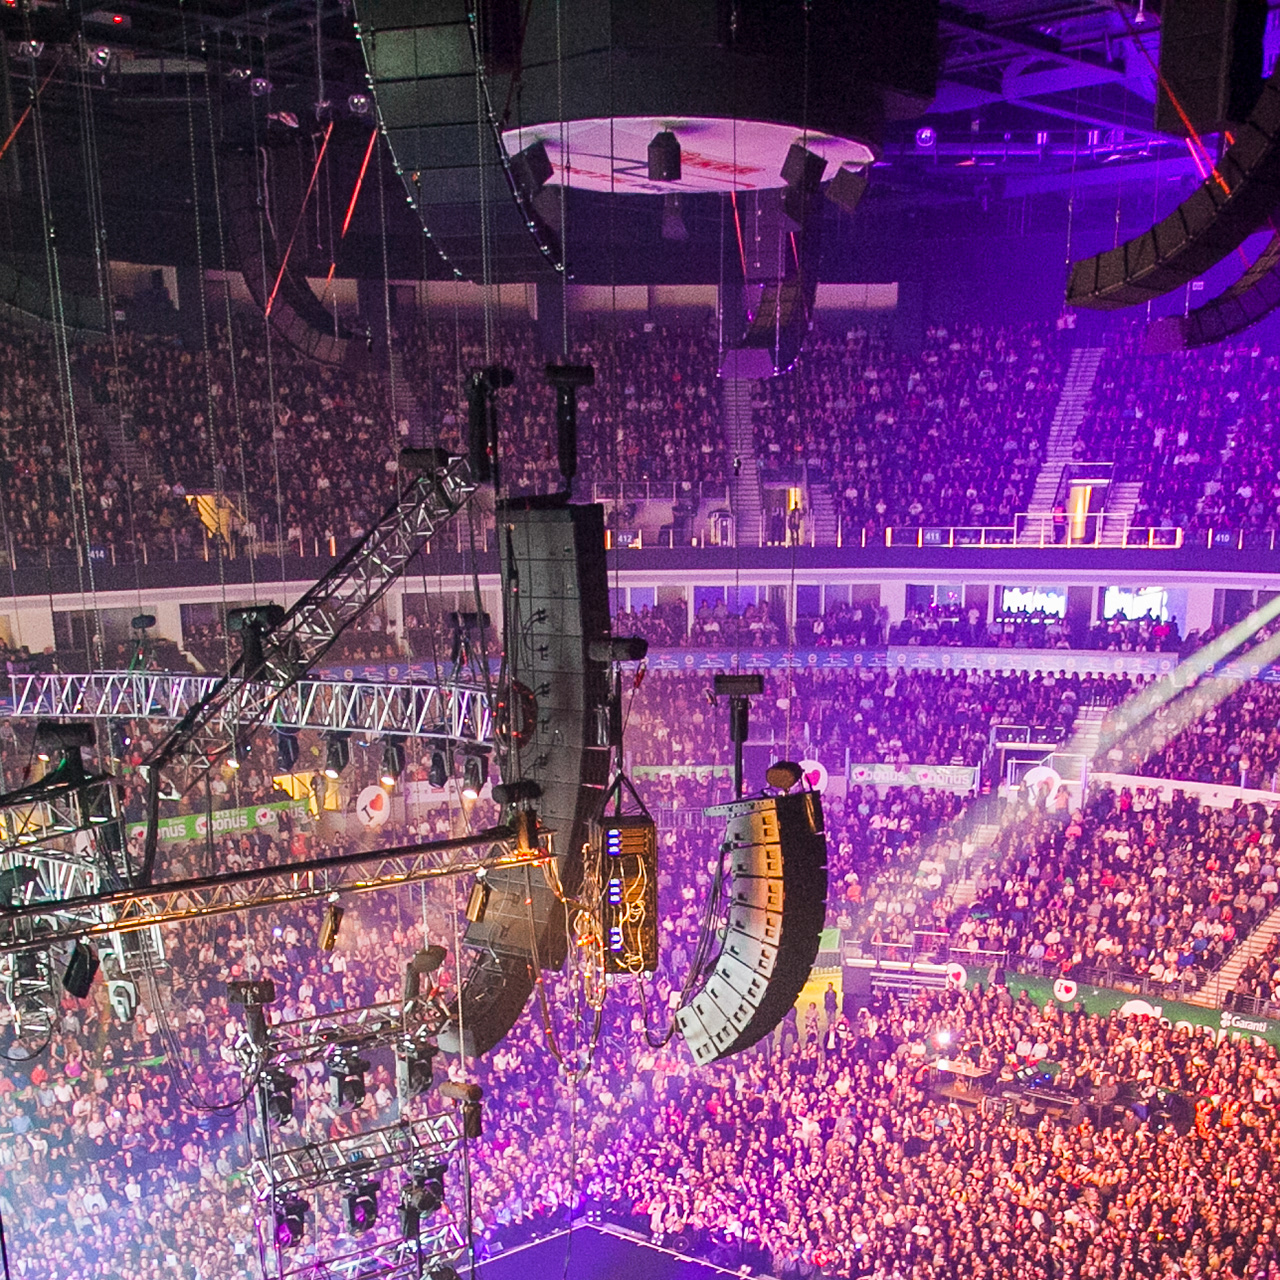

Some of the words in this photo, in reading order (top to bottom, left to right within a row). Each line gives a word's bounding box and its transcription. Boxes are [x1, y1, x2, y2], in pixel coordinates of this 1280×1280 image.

[617, 534, 632, 542] 412
[925, 532, 940, 541] 411
[1215, 534, 1230, 542] 410
[89, 549, 104, 558] 414
